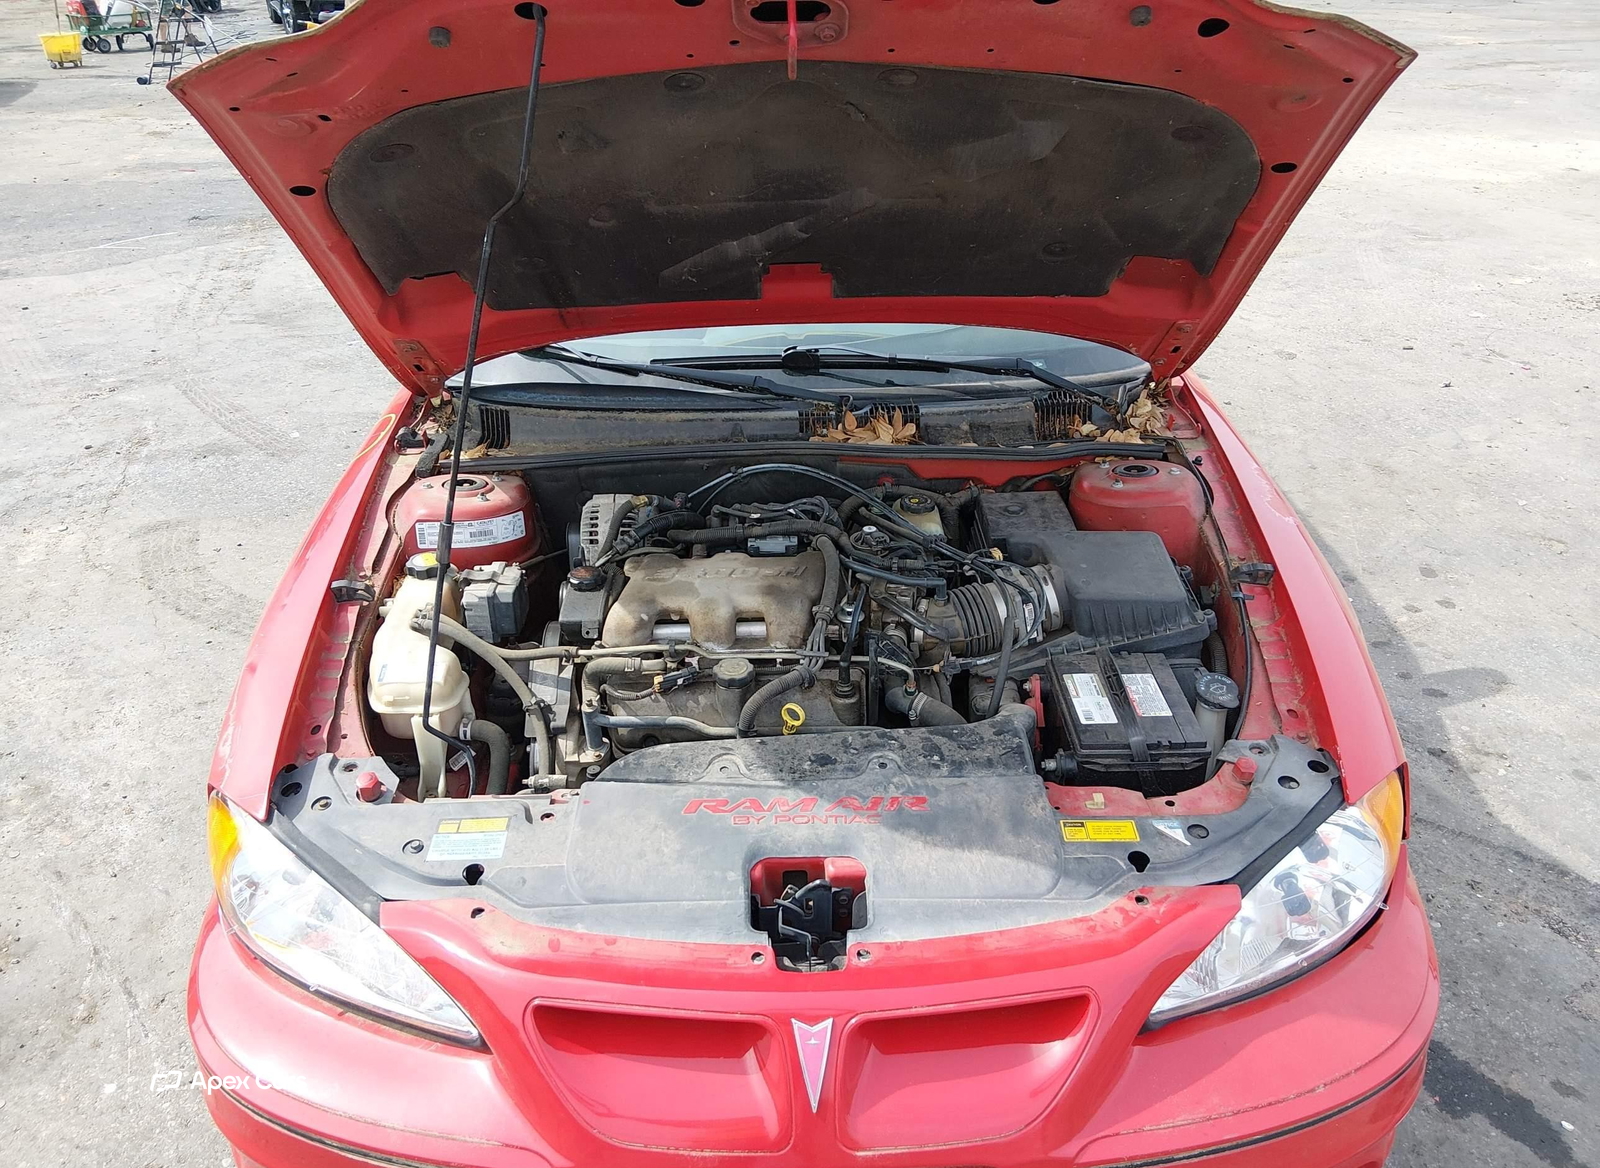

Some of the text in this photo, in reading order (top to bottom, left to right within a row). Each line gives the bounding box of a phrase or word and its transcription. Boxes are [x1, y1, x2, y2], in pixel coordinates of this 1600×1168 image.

[681, 795, 931, 815] RAM AIR
[731, 814, 883, 826] BY PONTIAC
